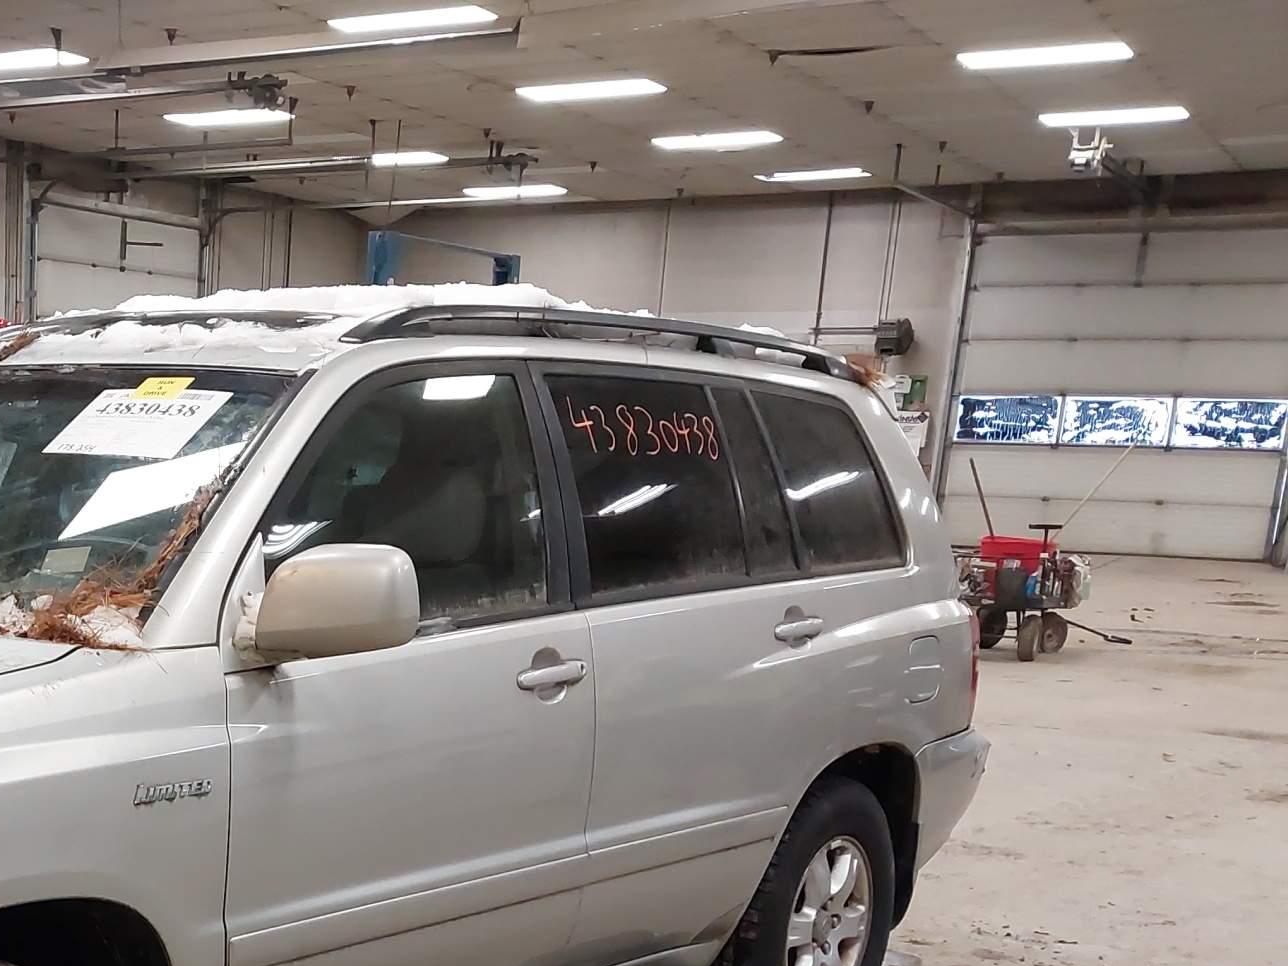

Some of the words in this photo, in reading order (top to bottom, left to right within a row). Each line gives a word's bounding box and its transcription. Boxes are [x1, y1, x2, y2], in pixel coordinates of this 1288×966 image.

[95, 402, 201, 418] 43830438
[566, 396, 720, 461] 43830438
[133, 779, 213, 806] LIMITED
